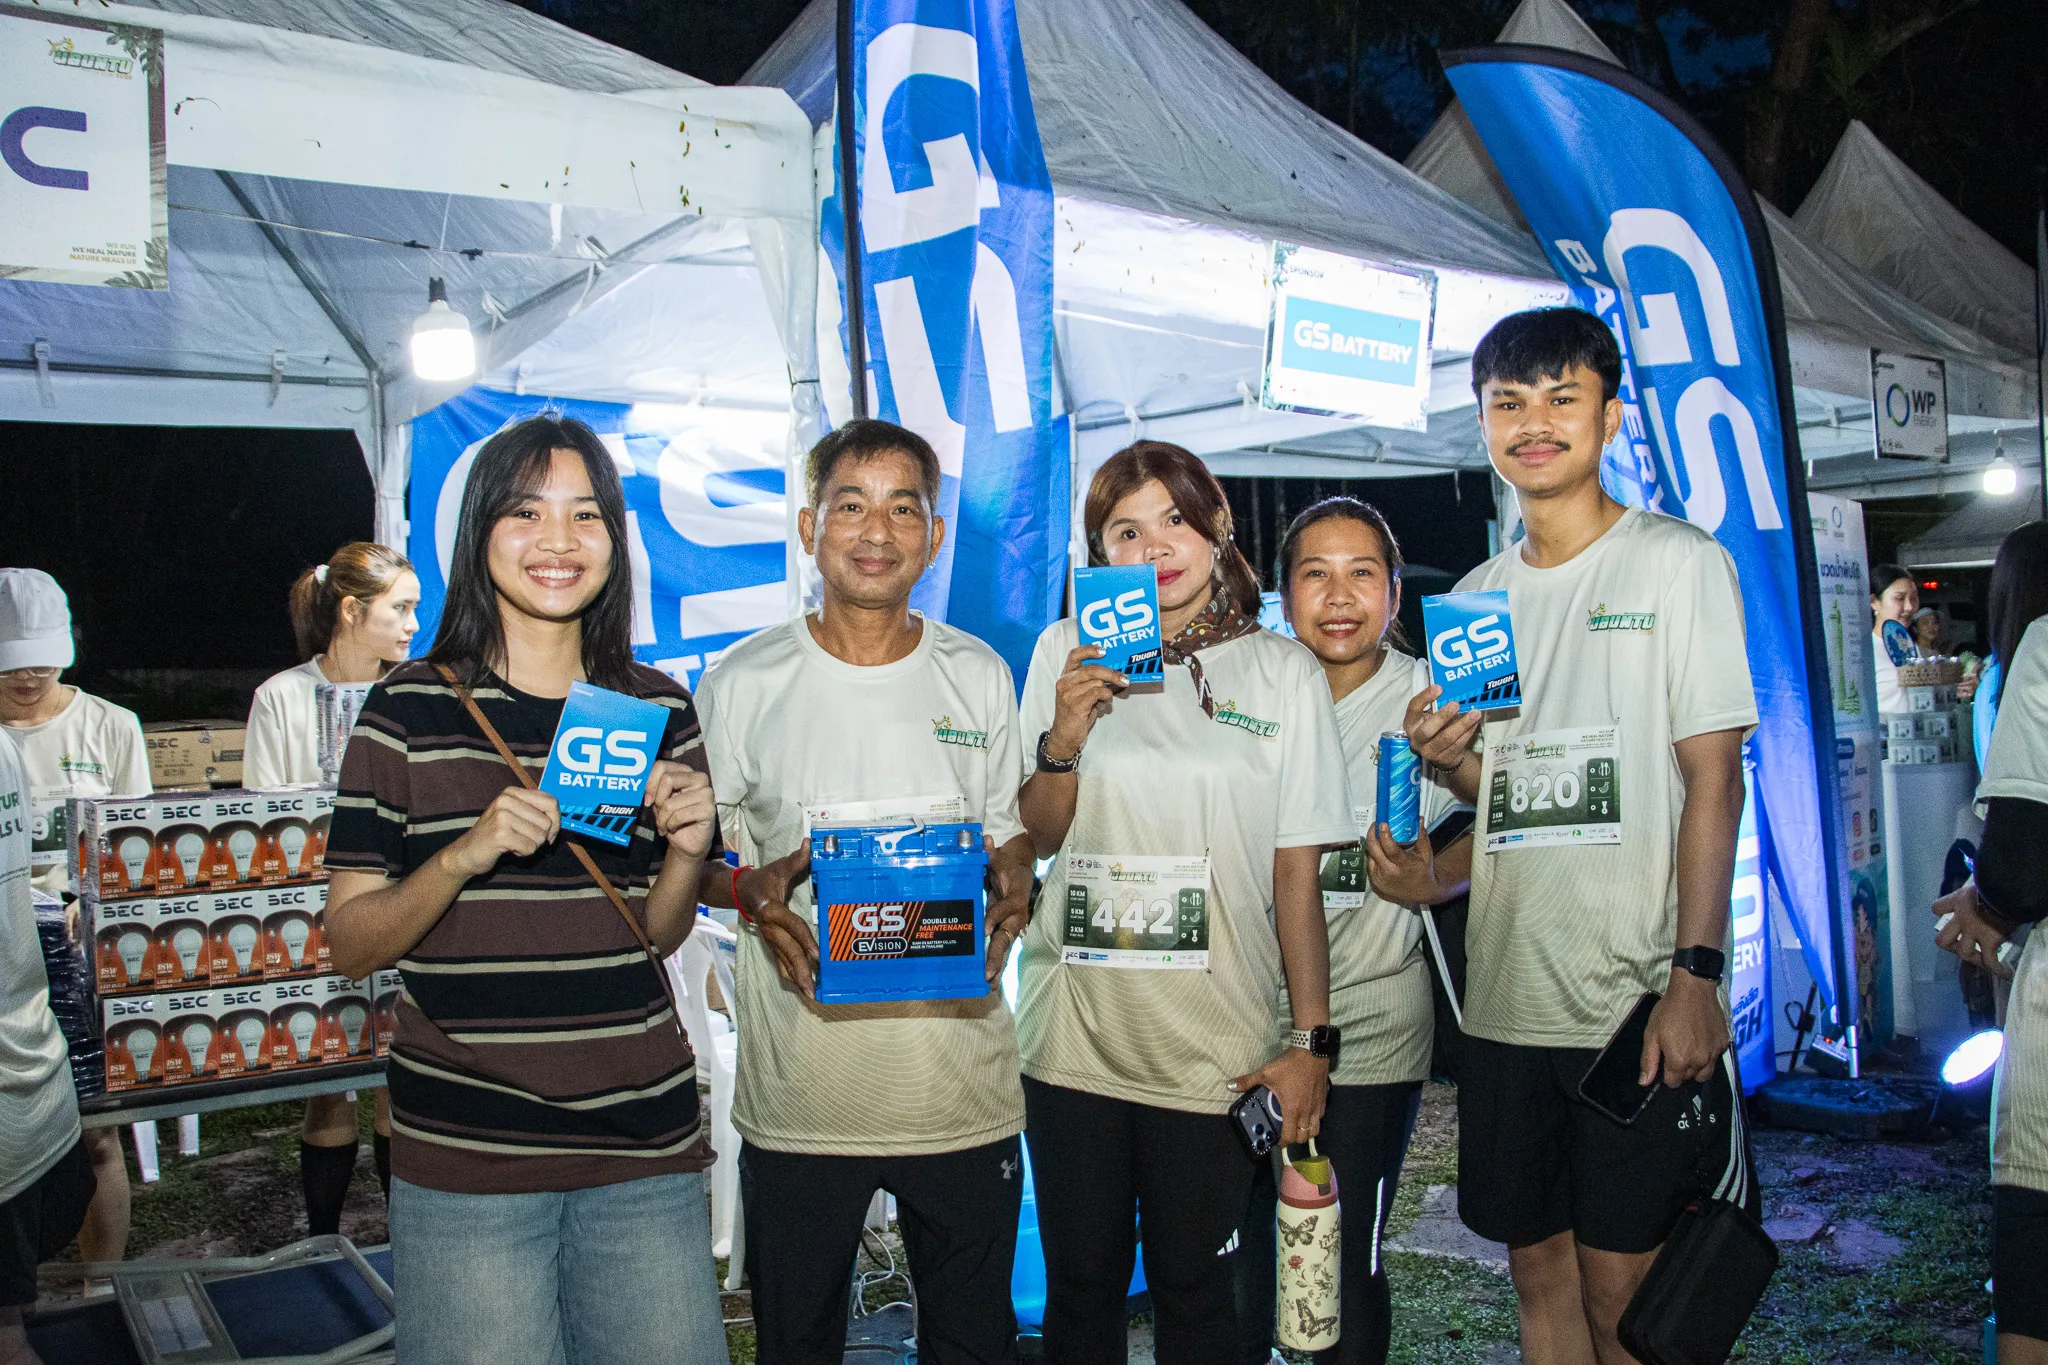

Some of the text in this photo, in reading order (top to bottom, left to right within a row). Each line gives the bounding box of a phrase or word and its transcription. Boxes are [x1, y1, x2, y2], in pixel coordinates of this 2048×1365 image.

[53, 50, 133, 74] UBUNTU
[69, 254, 100, 262] NATURE
[101, 256, 125, 264] HEALS
[107, 249, 136, 257] NATURE
[1289, 265, 1325, 279] SPONSOR
[1294, 319, 1413, 364] GS BATTERY
[1602, 207, 1784, 534] GS
[1911, 389, 1936, 414] WP
[1081, 588, 1153, 638] GS
[1588, 614, 1655, 631] UBUNTU
[1432, 614, 1508, 667] GS
[1445, 651, 1511, 682] BATTERY
[1216, 711, 1280, 737] UBUNTU
[557, 726, 648, 776] GS
[1525, 744, 1566, 759] UBUNTU
[559, 772, 642, 791] BATTERY
[1511, 771, 1580, 813] 820
[1110, 871, 1158, 881] UBUNTU
[852, 905, 906, 932] GS
[919, 923, 973, 932] MAINTENANCE
[1091, 898, 1174, 934] 442
